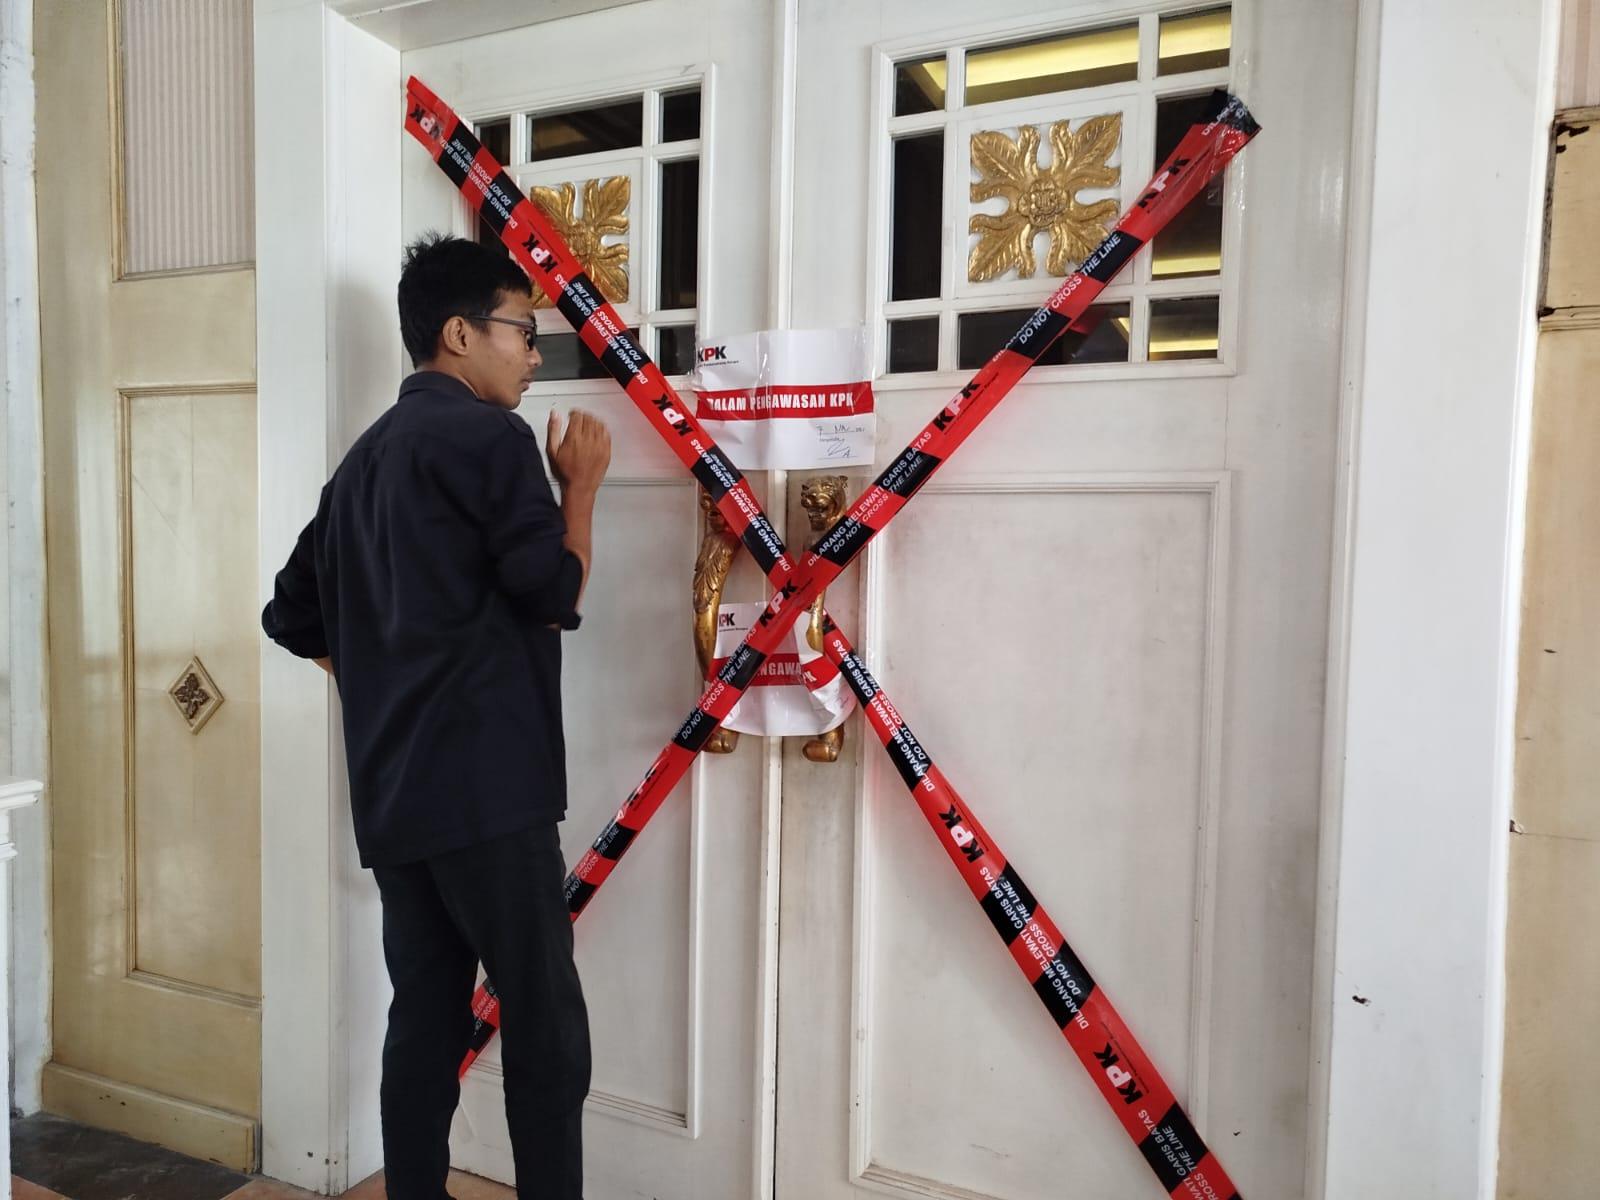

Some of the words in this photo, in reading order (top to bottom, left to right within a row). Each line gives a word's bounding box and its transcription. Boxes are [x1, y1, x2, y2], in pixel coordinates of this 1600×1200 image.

[451, 137, 467, 154] LINE
[462, 151, 476, 165] THE
[451, 151, 470, 172] GARIS
[472, 162, 492, 184] CROSS
[466, 168, 493, 199] MELEWATI
[488, 181, 503, 196] NOT
[489, 195, 519, 228] DILARANG
[498, 192, 511, 206] DO
[519, 232, 559, 273] KPK
[553, 272, 575, 296] BATAS
[572, 279, 590, 298] LINE
[1018, 325, 1035, 344] DO
[1031, 307, 1052, 330] NOT
[1050, 274, 1083, 310] CROSS
[1080, 255, 1100, 277] THE
[1097, 233, 1122, 259] LINE
[570, 293, 592, 316] GARIS
[585, 295, 601, 312] THE
[588, 313, 620, 349] MELEWATI
[596, 309, 621, 336] CROSS
[615, 332, 632, 350] NOT
[627, 347, 641, 362] DO
[615, 347, 648, 384] DILARANG
[651, 391, 694, 437] KPK
[750, 393, 826, 411] PENGAWASAN
[931, 377, 982, 430] KPK
[689, 438, 713, 464] BATAS
[709, 462, 731, 488] GARIS
[727, 486, 761, 529] MELEWATI
[736, 486, 759, 515] CROSS
[806, 525, 847, 567] DILARANG
[843, 485, 885, 528] MELEWATI
[881, 458, 909, 487] GARIS
[905, 431, 933, 461] BATAS
[831, 537, 847, 553] DO
[843, 520, 863, 540] NOT
[860, 492, 889, 523] CROSS
[887, 474, 906, 494] THE
[903, 455, 924, 478] LINE
[756, 513, 772, 532] NOT
[757, 527, 791, 571] DILARANG
[769, 530, 782, 545] DO
[757, 578, 799, 628] KPK
[832, 638, 856, 669] BATAS
[680, 724, 694, 739] DO
[690, 708, 706, 726] NOT
[702, 682, 726, 711] CROSS
[722, 667, 738, 684] THE
[733, 649, 751, 669] LINE
[851, 667, 874, 697] GARIS
[865, 674, 881, 692] THE
[869, 696, 904, 744] MELEWATI
[878, 692, 903, 725] CROSS
[899, 725, 916, 745] NOT
[912, 744, 926, 760] DO
[899, 742, 935, 791] DILARANG
[937, 803, 984, 863] KPK
[578, 853, 600, 879] CROSS
[978, 865, 1004, 898] BATAS
[999, 879, 1021, 904] LINE
[998, 897, 1024, 930] GARIS
[1015, 902, 1033, 923] THE
[1018, 928, 1056, 978] MELEWATI
[1028, 922, 1056, 958] CROSS
[1051, 957, 1071, 980] NOT
[1065, 978, 1081, 996] DO
[1051, 977, 1089, 1029] DILARANG
[1092, 1042, 1144, 1106] KPK
[1137, 1108, 1165, 1144] BATAS
[1161, 1123, 1184, 1151] LINE
[1160, 1142, 1187, 1177] GARIS
[1178, 1149, 1198, 1173] THE
[1194, 1172, 1218, 1200] ROSS
